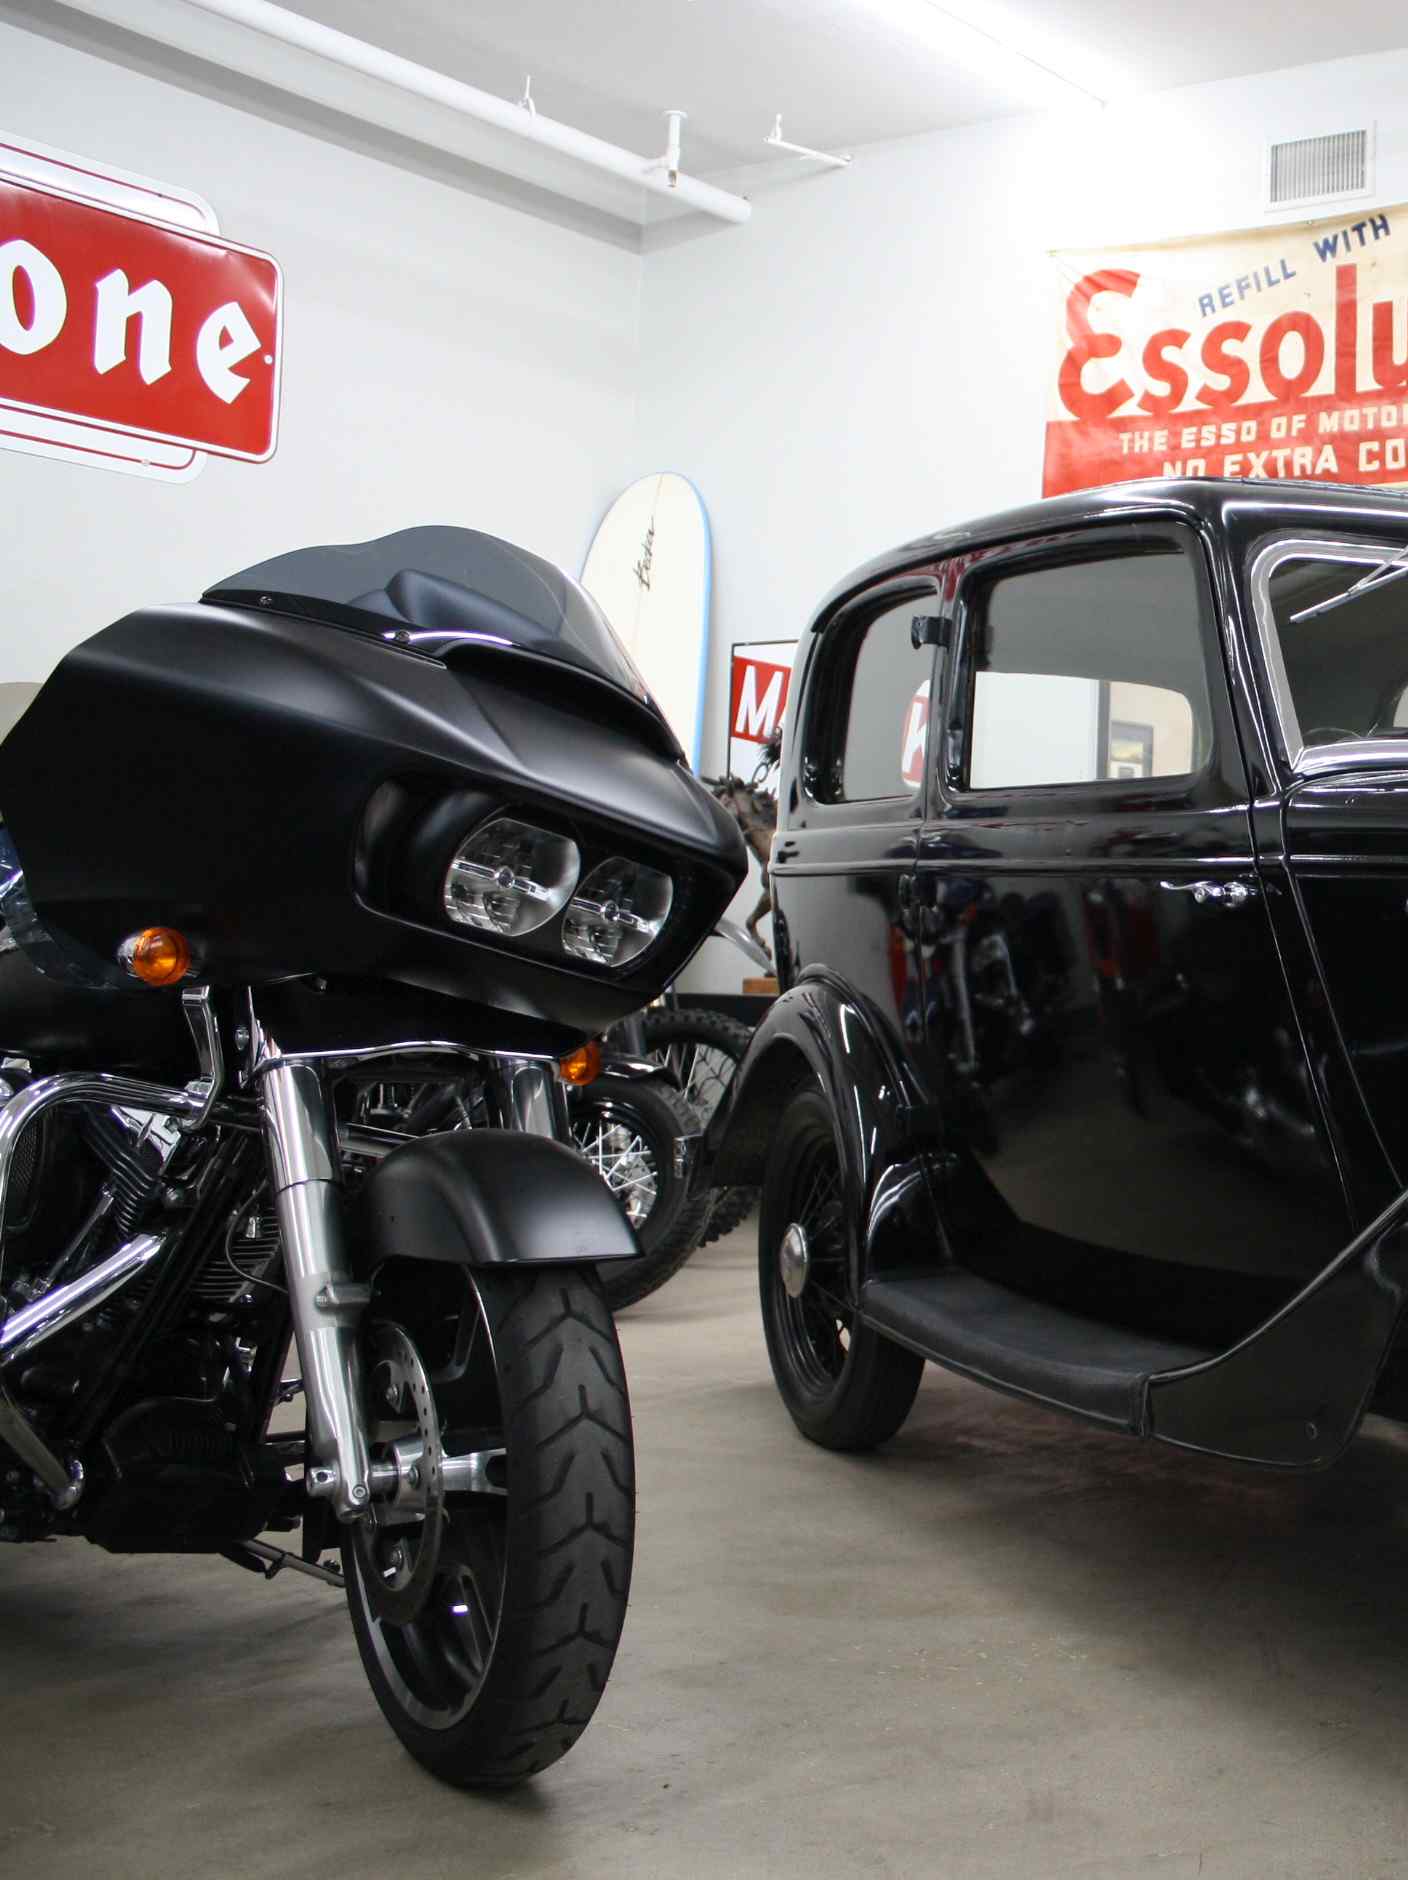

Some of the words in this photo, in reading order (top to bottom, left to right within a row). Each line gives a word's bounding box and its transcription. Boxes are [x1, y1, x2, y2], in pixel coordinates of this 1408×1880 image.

[1198, 259, 1297, 318] REFILL
[1313, 213, 1391, 263] WITH
[1120, 428, 1168, 455] THE
[1180, 419, 1258, 450] ESSO
[1270, 414, 1307, 438] OF
[1223, 444, 1339, 479] EXTRA
